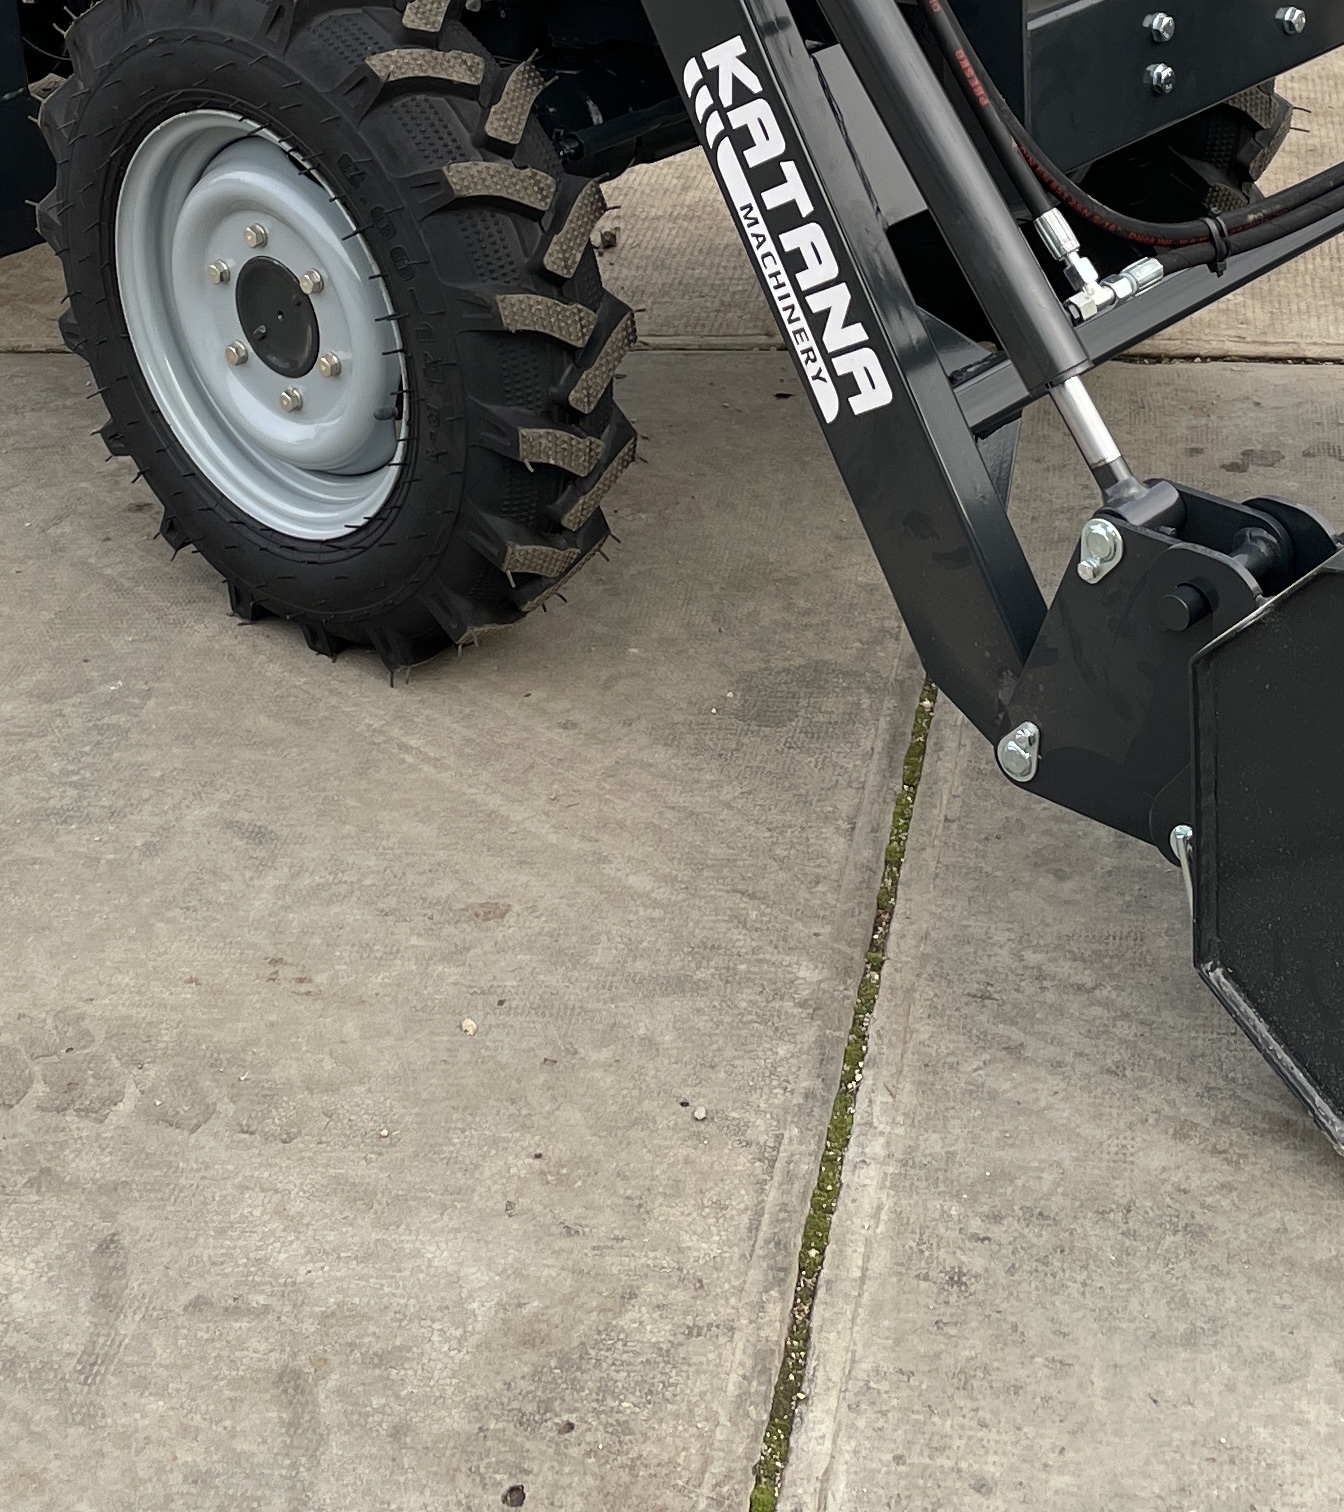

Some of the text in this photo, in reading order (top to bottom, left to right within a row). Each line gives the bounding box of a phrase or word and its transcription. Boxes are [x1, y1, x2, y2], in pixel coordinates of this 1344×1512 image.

[956, 50, 988, 105] PRESKO
[702, 35, 893, 415] KATANA
[738, 202, 828, 386] MACHINERY
